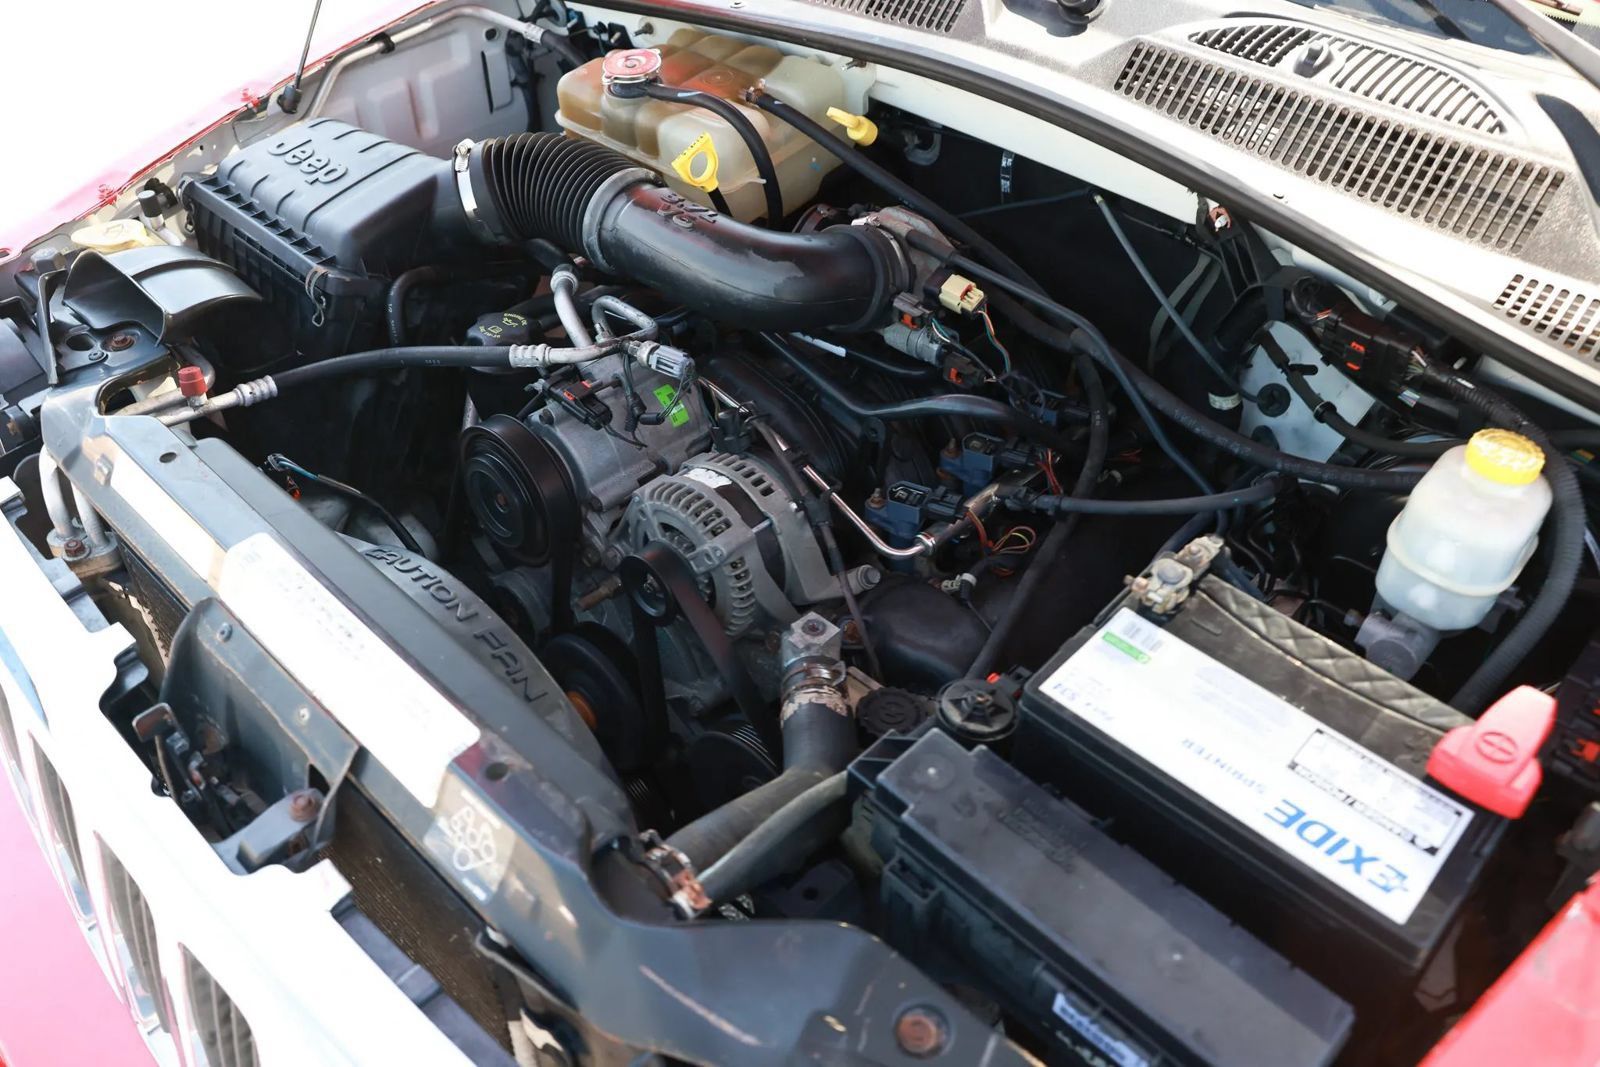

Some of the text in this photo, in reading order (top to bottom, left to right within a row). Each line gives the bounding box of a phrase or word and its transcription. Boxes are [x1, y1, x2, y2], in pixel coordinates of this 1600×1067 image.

[267, 137, 348, 186] Jeep
[365, 549, 479, 622] CAUTION
[473, 629, 548, 703] FAN
[1181, 738, 1266, 795] SPRINTER
[1263, 798, 1409, 893] EXIDE
